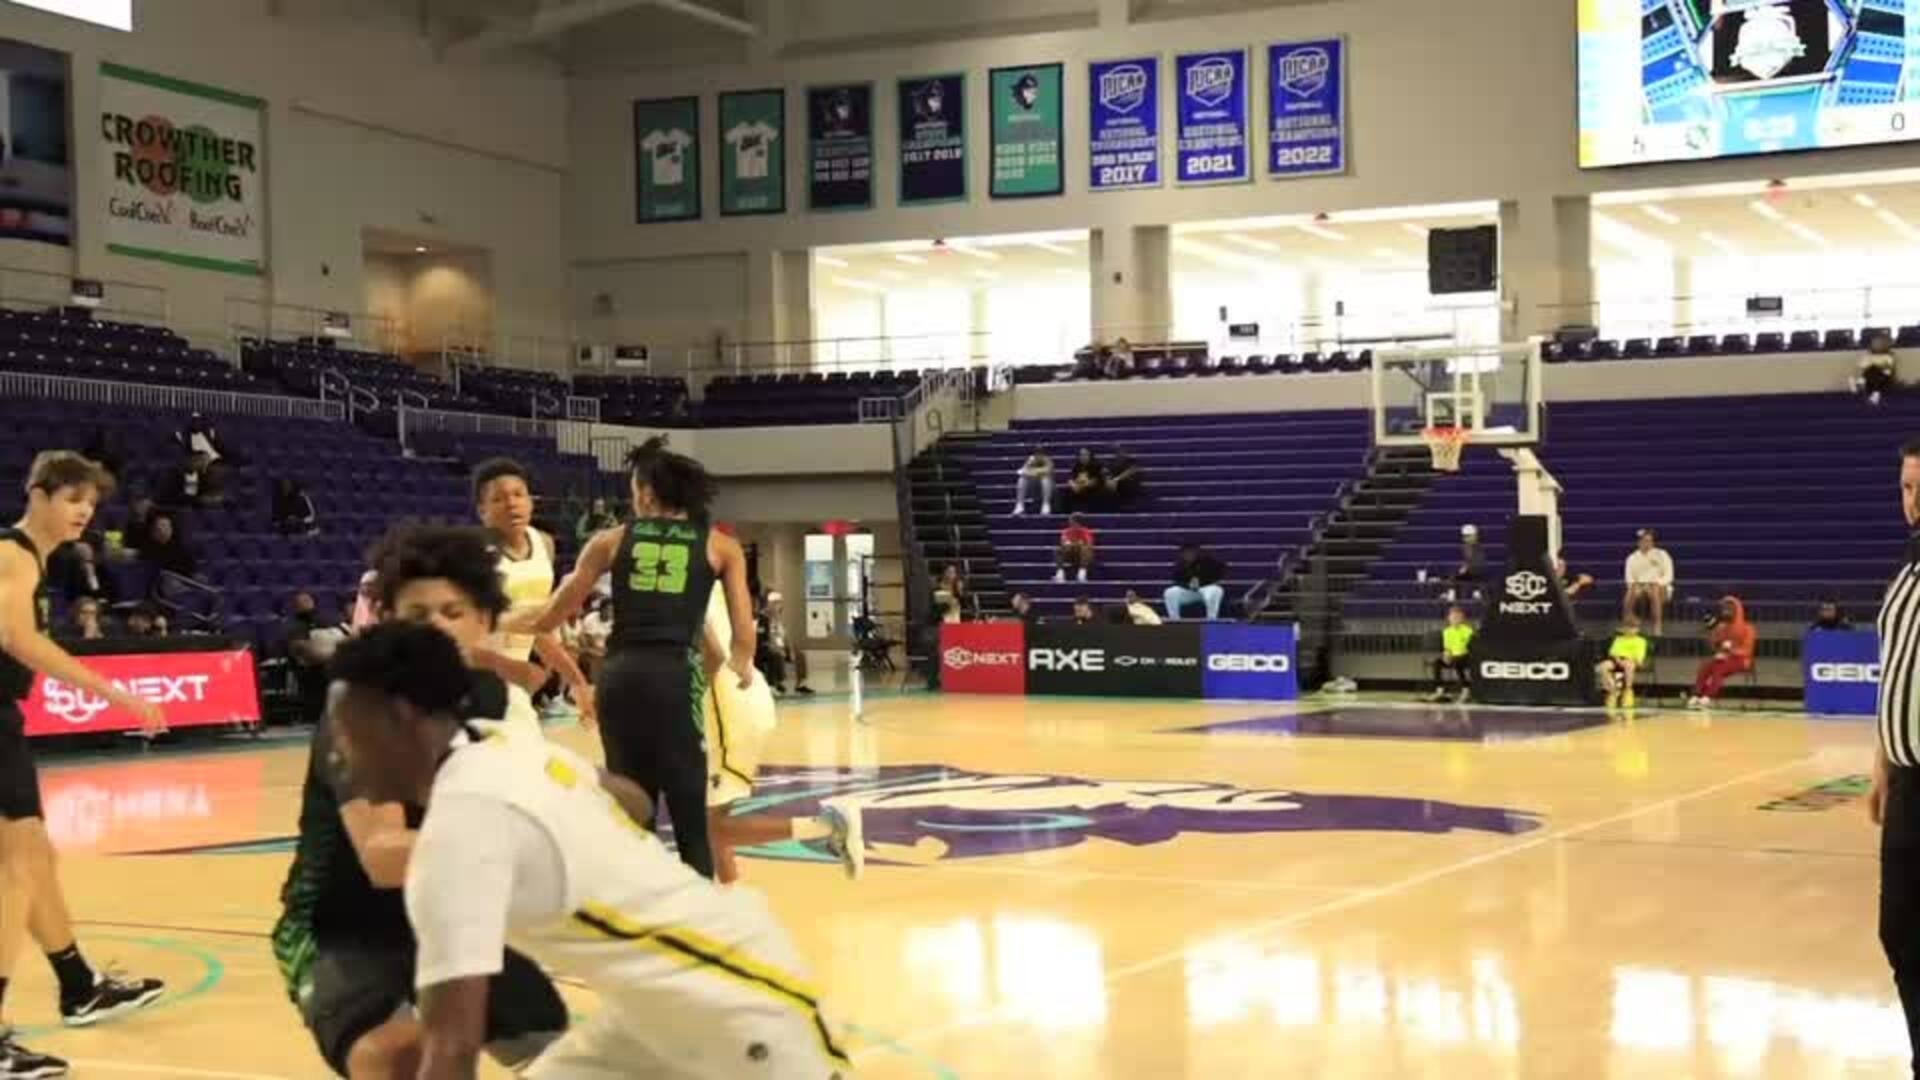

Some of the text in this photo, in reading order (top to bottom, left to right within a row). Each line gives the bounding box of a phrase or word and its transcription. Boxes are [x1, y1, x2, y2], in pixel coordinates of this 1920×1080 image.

[101, 111, 257, 173] CROWTHER
[1187, 154, 1235, 175] 2021
[1277, 145, 1332, 166] 2022
[114, 152, 243, 203] ROOFING
[1101, 165, 1147, 185] 2017
[629, 540, 690, 594] 33
[1499, 601, 1553, 614] NEXT
[973, 652, 1021, 665] NEXT
[1029, 648, 1105, 672] AXE
[1207, 653, 1290, 673] GEICO
[1481, 661, 1570, 680] GEICO
